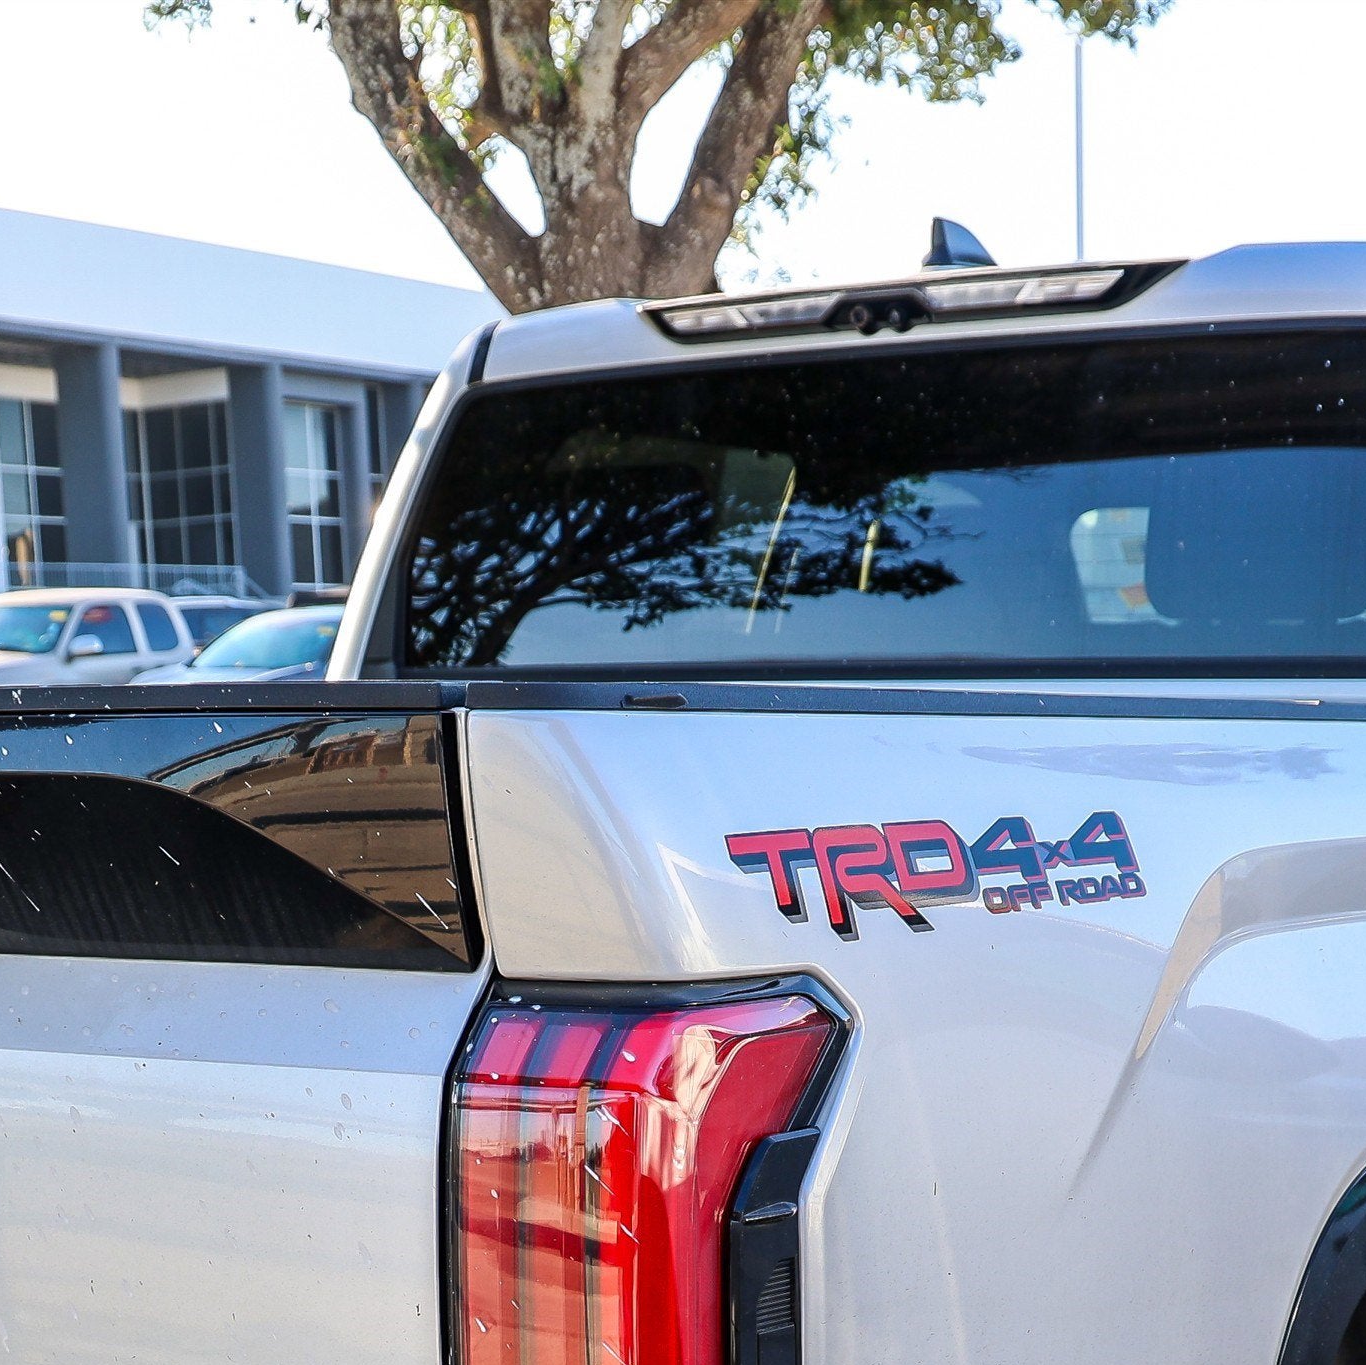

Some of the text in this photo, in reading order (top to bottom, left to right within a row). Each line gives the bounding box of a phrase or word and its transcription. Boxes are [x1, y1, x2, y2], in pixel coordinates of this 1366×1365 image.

[725, 818, 979, 942] TRD
[982, 871, 1146, 914] OFF ROAD
